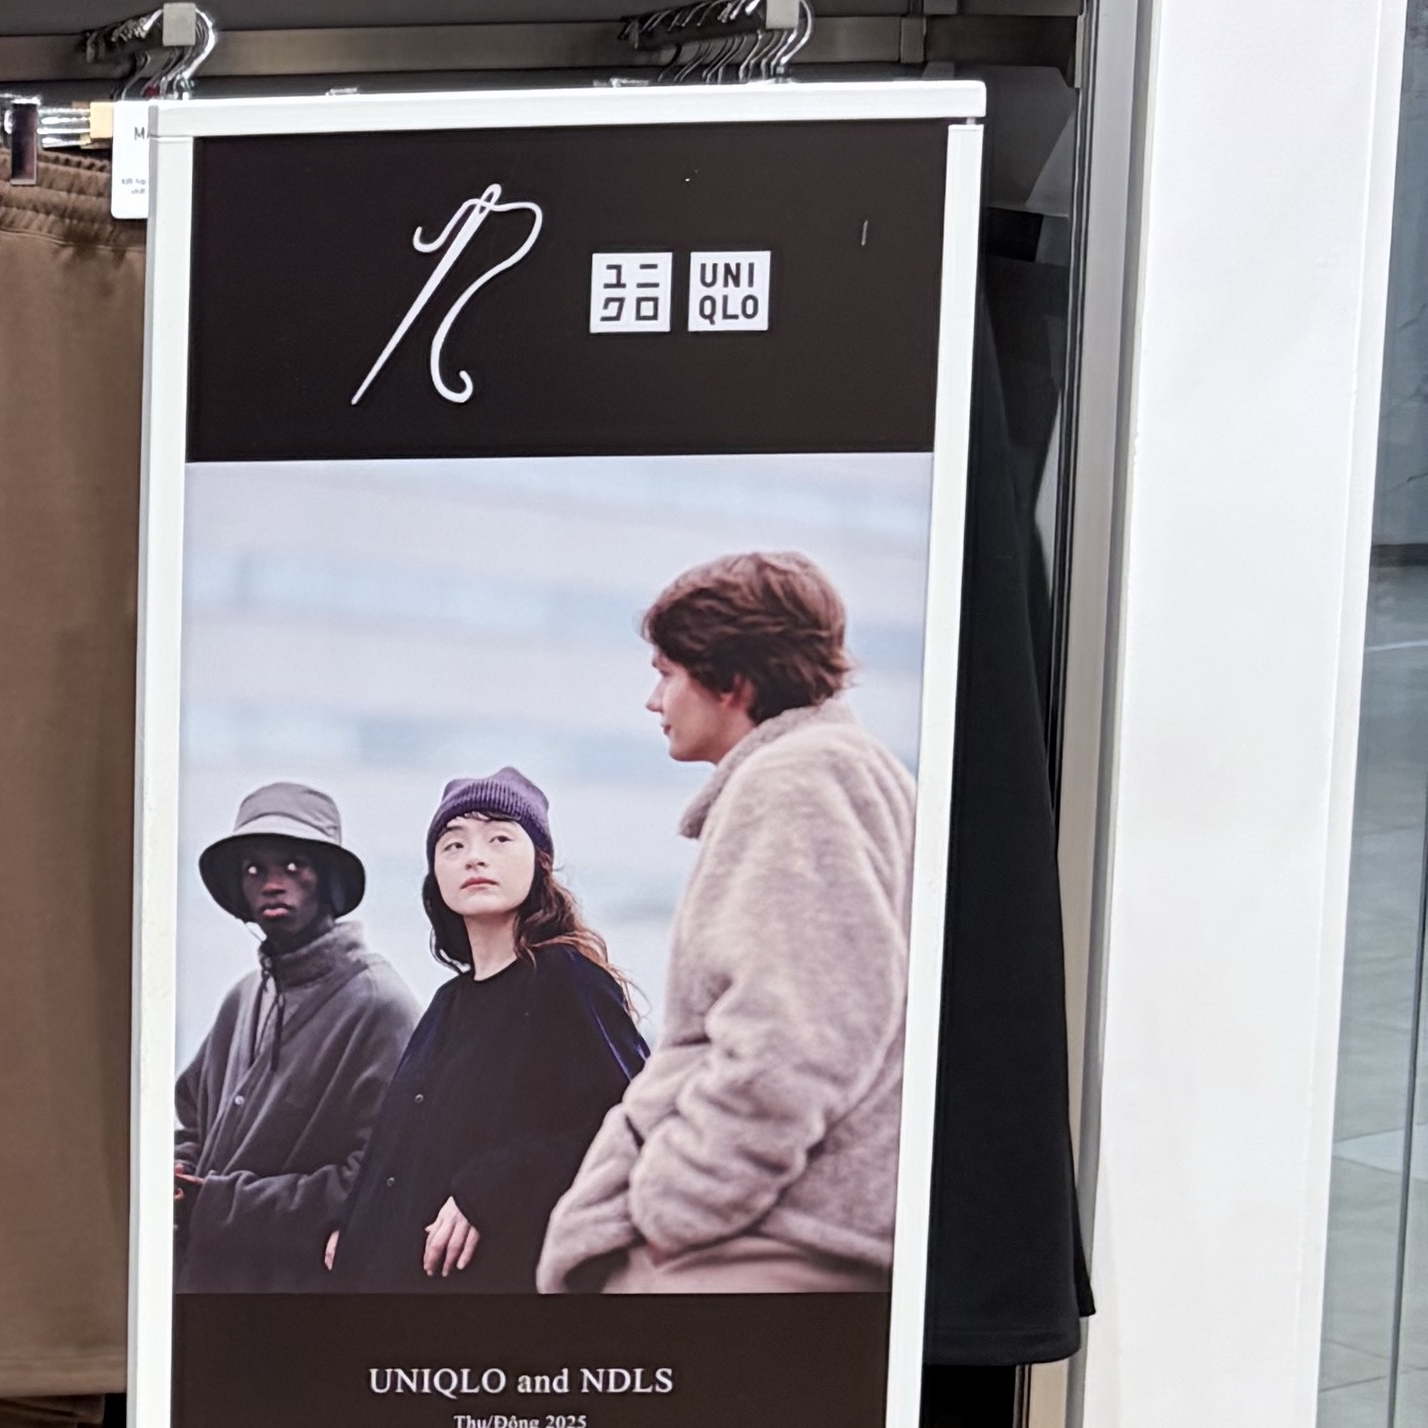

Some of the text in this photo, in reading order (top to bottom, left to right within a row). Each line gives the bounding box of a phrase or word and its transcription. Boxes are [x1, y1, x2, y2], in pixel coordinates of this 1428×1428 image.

[369, 1367, 673, 1399] UNIQLO and NDLS
